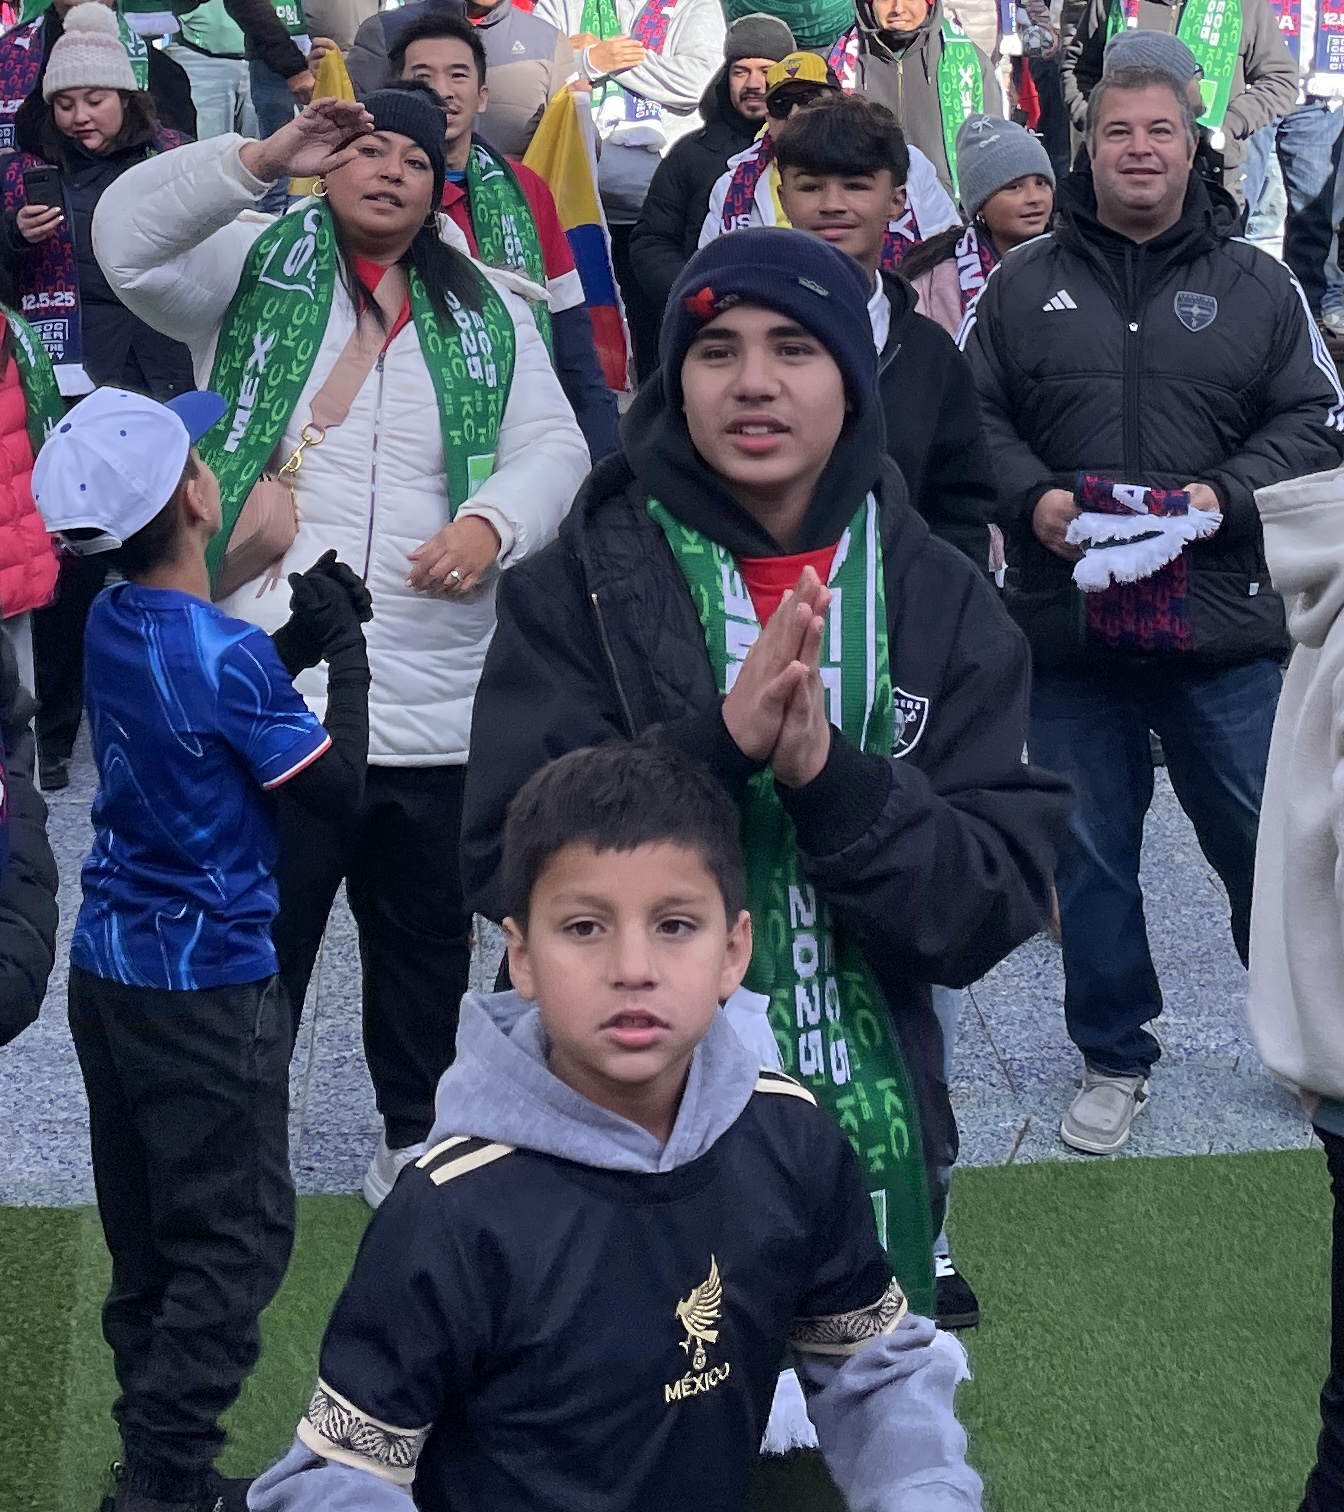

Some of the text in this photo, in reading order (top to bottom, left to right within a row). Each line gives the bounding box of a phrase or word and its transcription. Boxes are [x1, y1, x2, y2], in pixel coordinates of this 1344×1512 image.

[720, 214, 750, 234] US
[22, 292, 76, 310] 12.5.25
[421, 312, 442, 354] KC
[445, 290, 484, 381] 2025
[471, 310, 493, 355] EC
[225, 329, 276, 453] MEX
[788, 885, 825, 1076] 2025
[664, 1362, 731, 1405] MÉXICO
